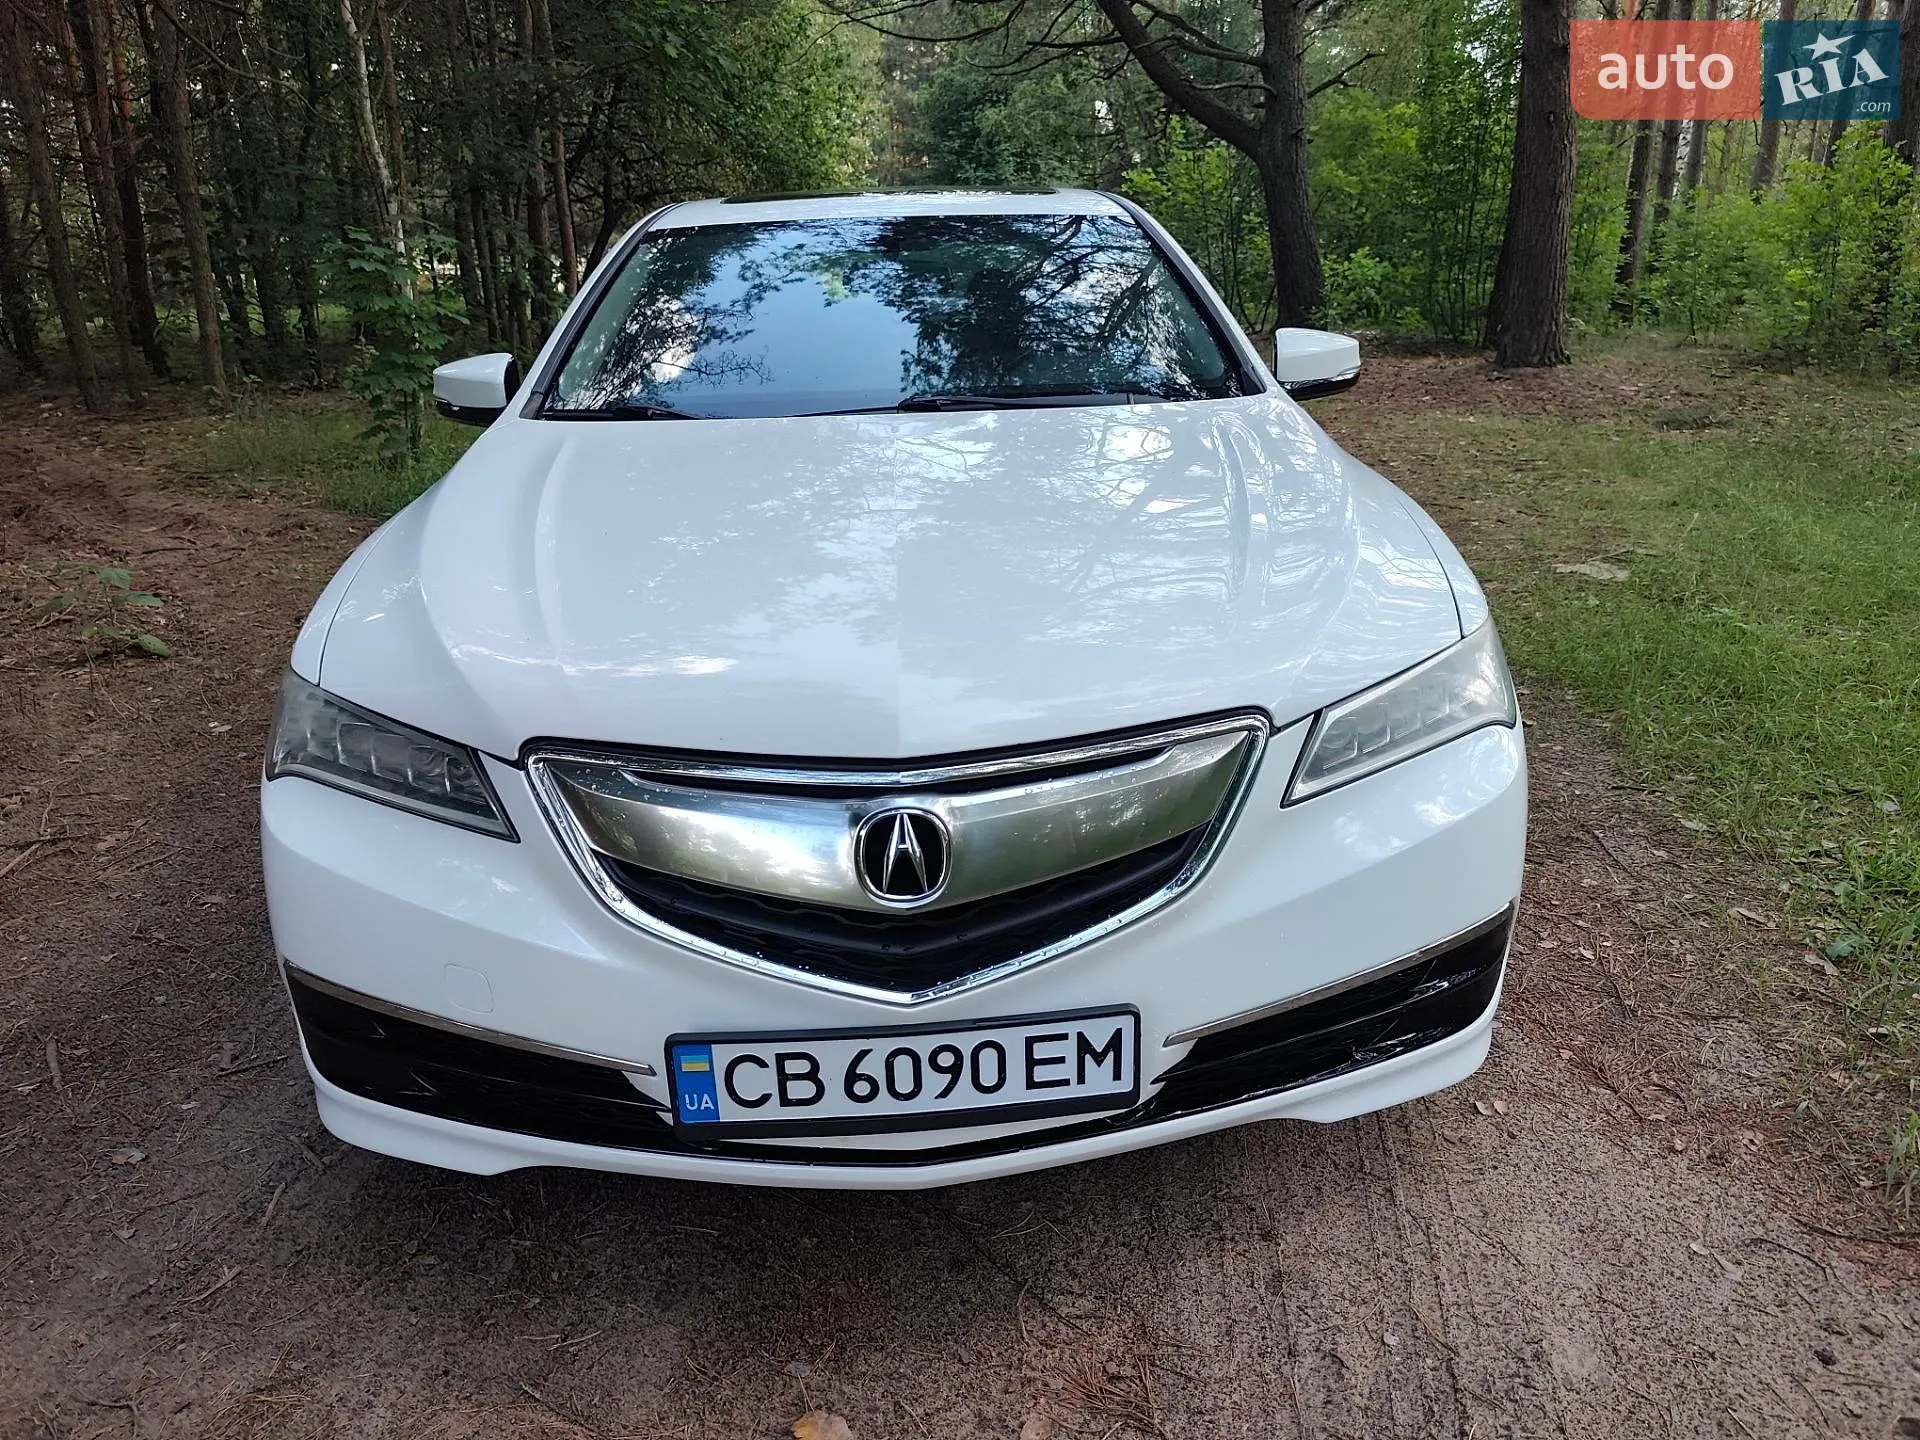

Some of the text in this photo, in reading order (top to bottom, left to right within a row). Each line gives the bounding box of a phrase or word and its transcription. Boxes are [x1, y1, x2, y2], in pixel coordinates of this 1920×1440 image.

[724, 1027, 1123, 1109] CB 6090 EM
[684, 1094, 715, 1111] UA
